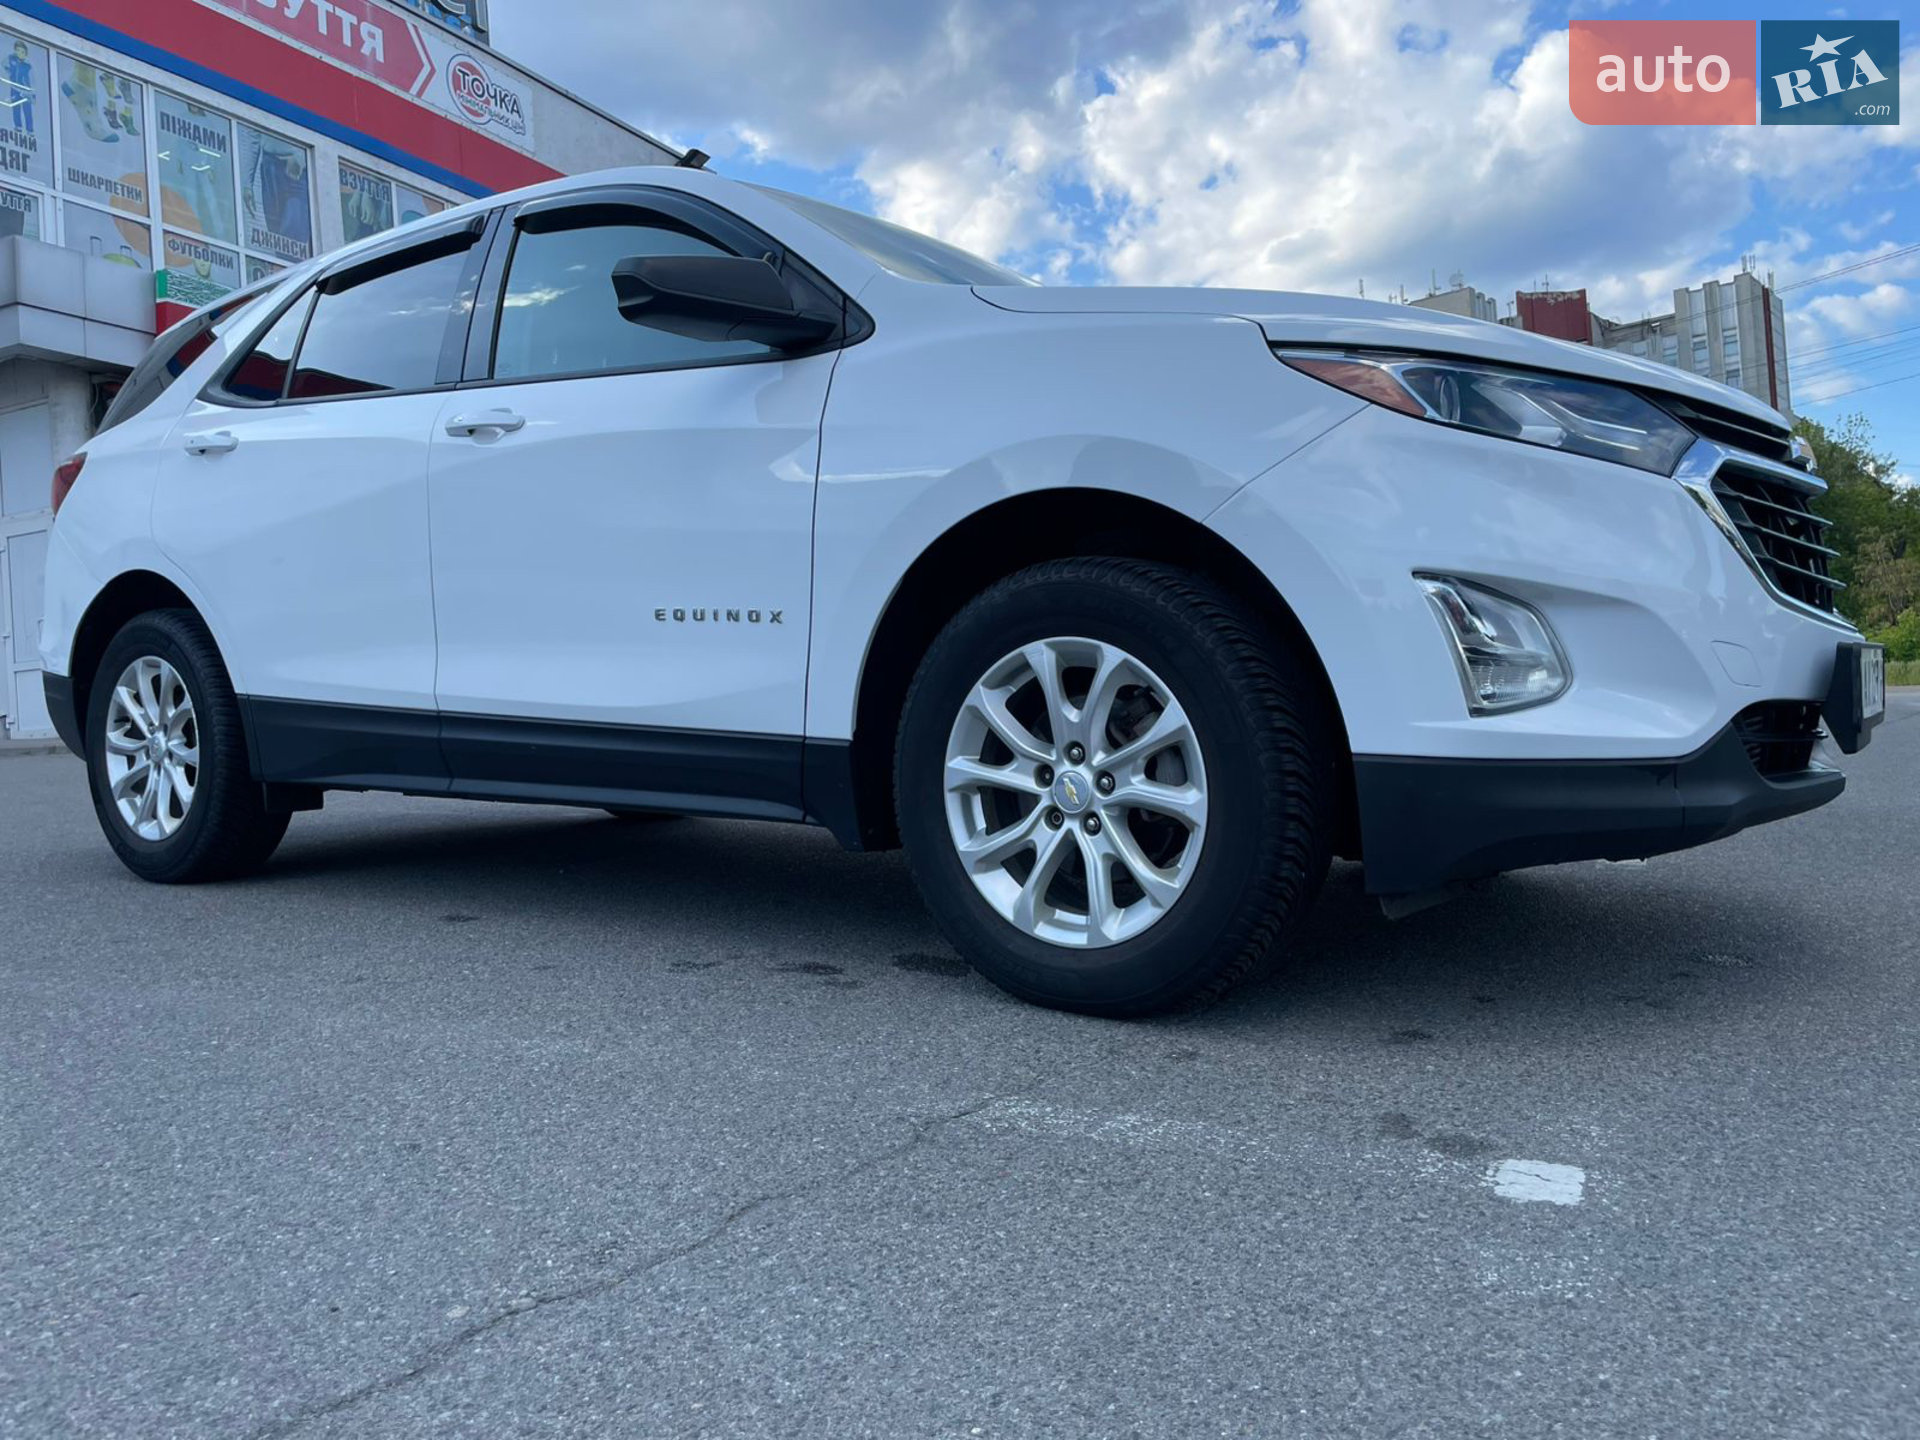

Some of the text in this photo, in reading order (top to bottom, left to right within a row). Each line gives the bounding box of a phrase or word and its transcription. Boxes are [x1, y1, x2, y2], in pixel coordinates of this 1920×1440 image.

[256, 0, 385, 63] УТТЯ
[456, 67, 522, 119] ТОЧКА
[159, 111, 228, 154] ПІЖАМИ
[67, 166, 143, 203] ШКАРПЕТКИ
[339, 167, 391, 202] ВЗУТТЯ
[167, 237, 234, 270] ФУТБОЛКИ
[250, 227, 308, 260] ДЖИНСИ
[654, 608, 783, 625] EQUINOX
